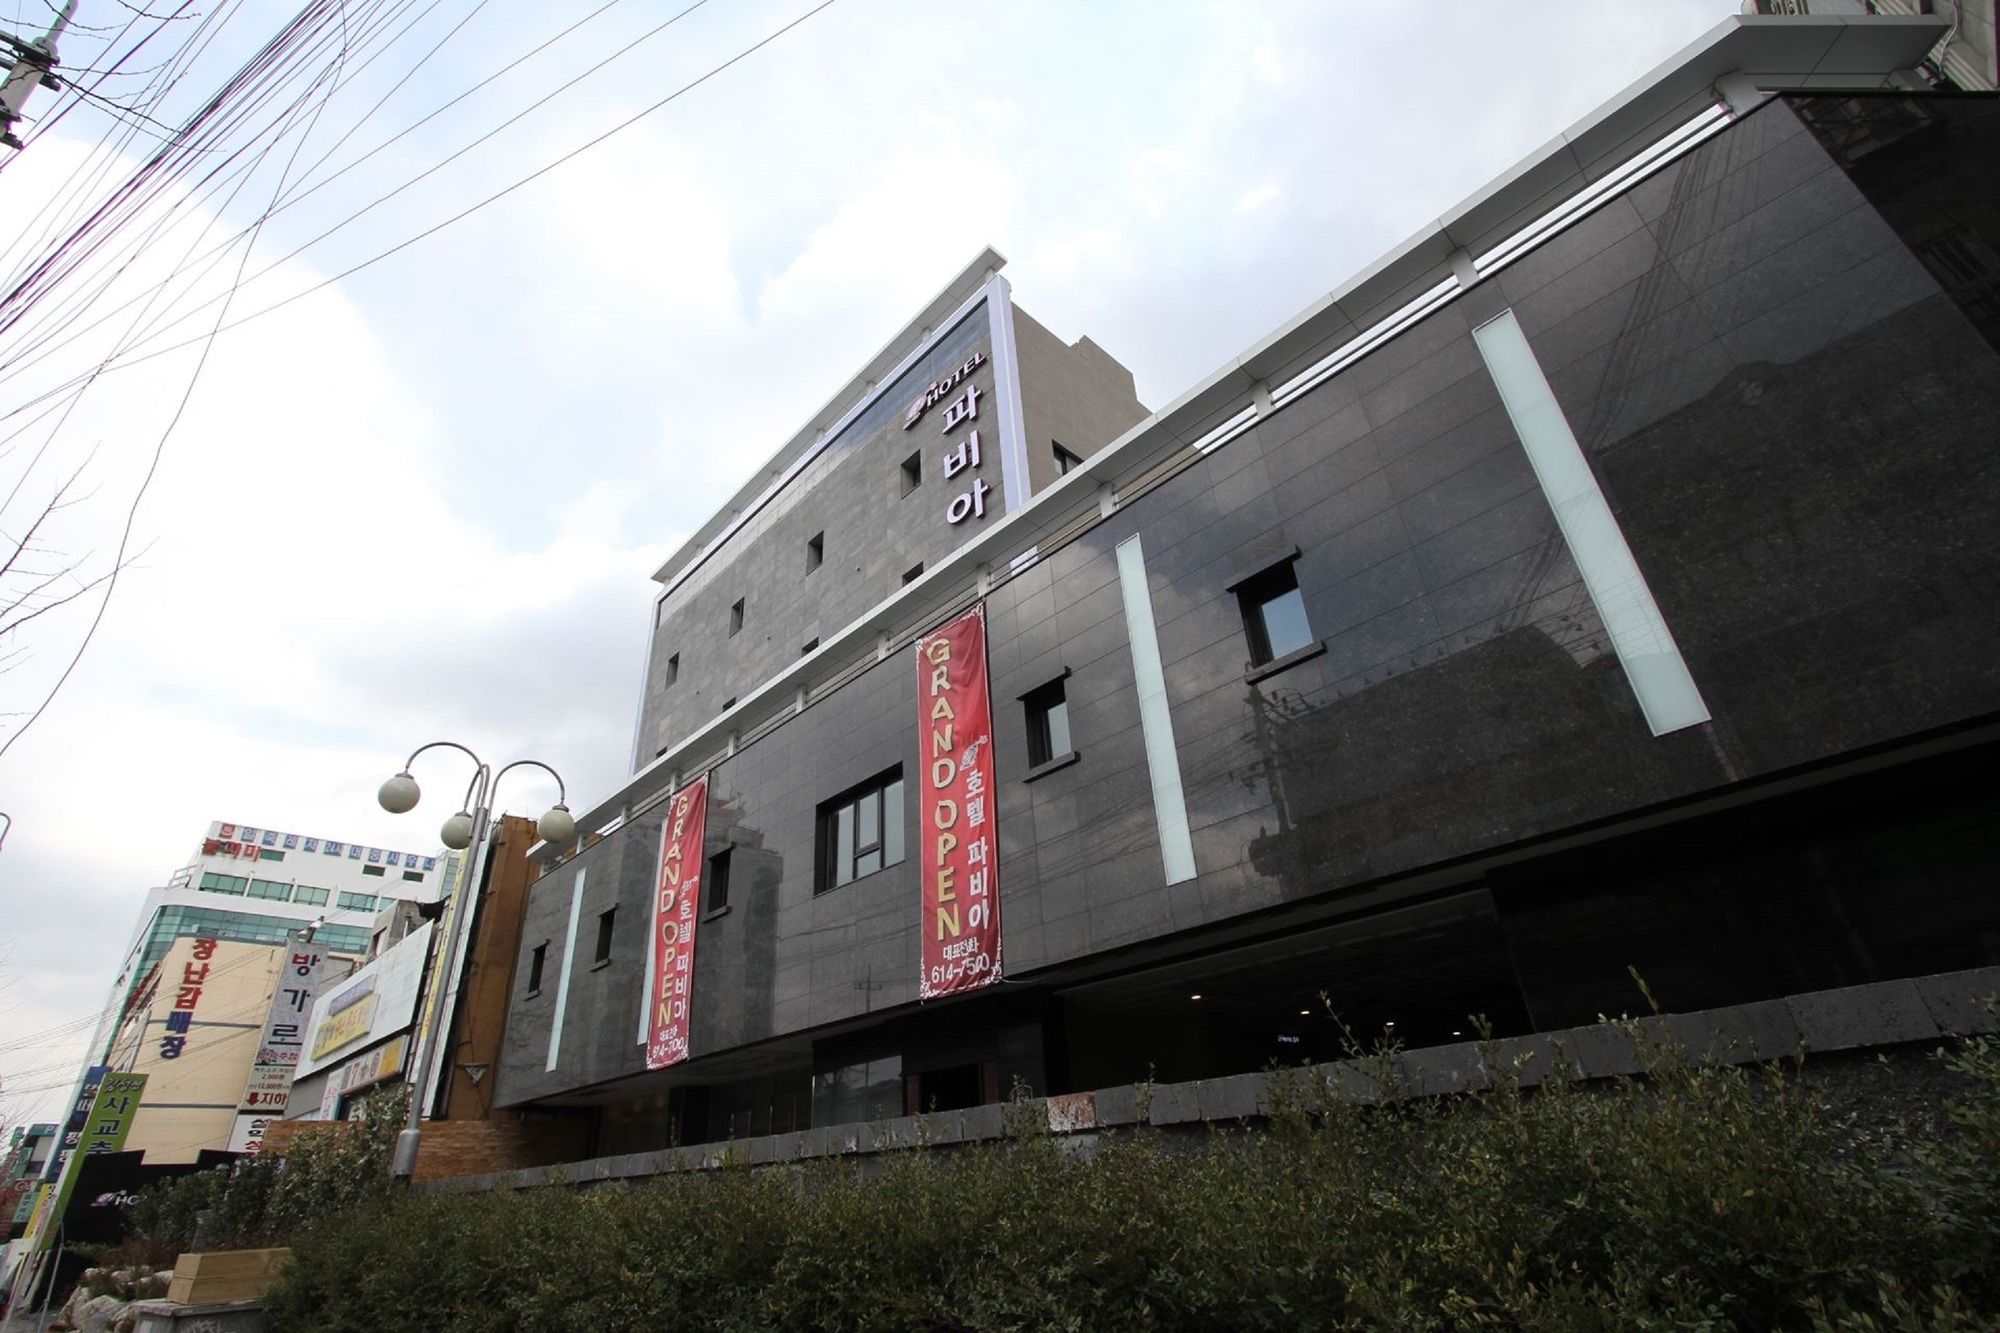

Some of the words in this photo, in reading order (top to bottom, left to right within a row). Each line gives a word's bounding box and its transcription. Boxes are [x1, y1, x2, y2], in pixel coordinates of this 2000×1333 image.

[927, 352, 987, 407] HOTEL
[943, 384, 990, 524] 파비아
[927, 637, 956, 789] GRAND
[661, 795, 688, 913] GRAND
[935, 799, 961, 941] OPEN
[968, 836, 990, 929] 파비아
[658, 921, 679, 1028] OPEN
[260, 1091, 288, 1105] 지하
